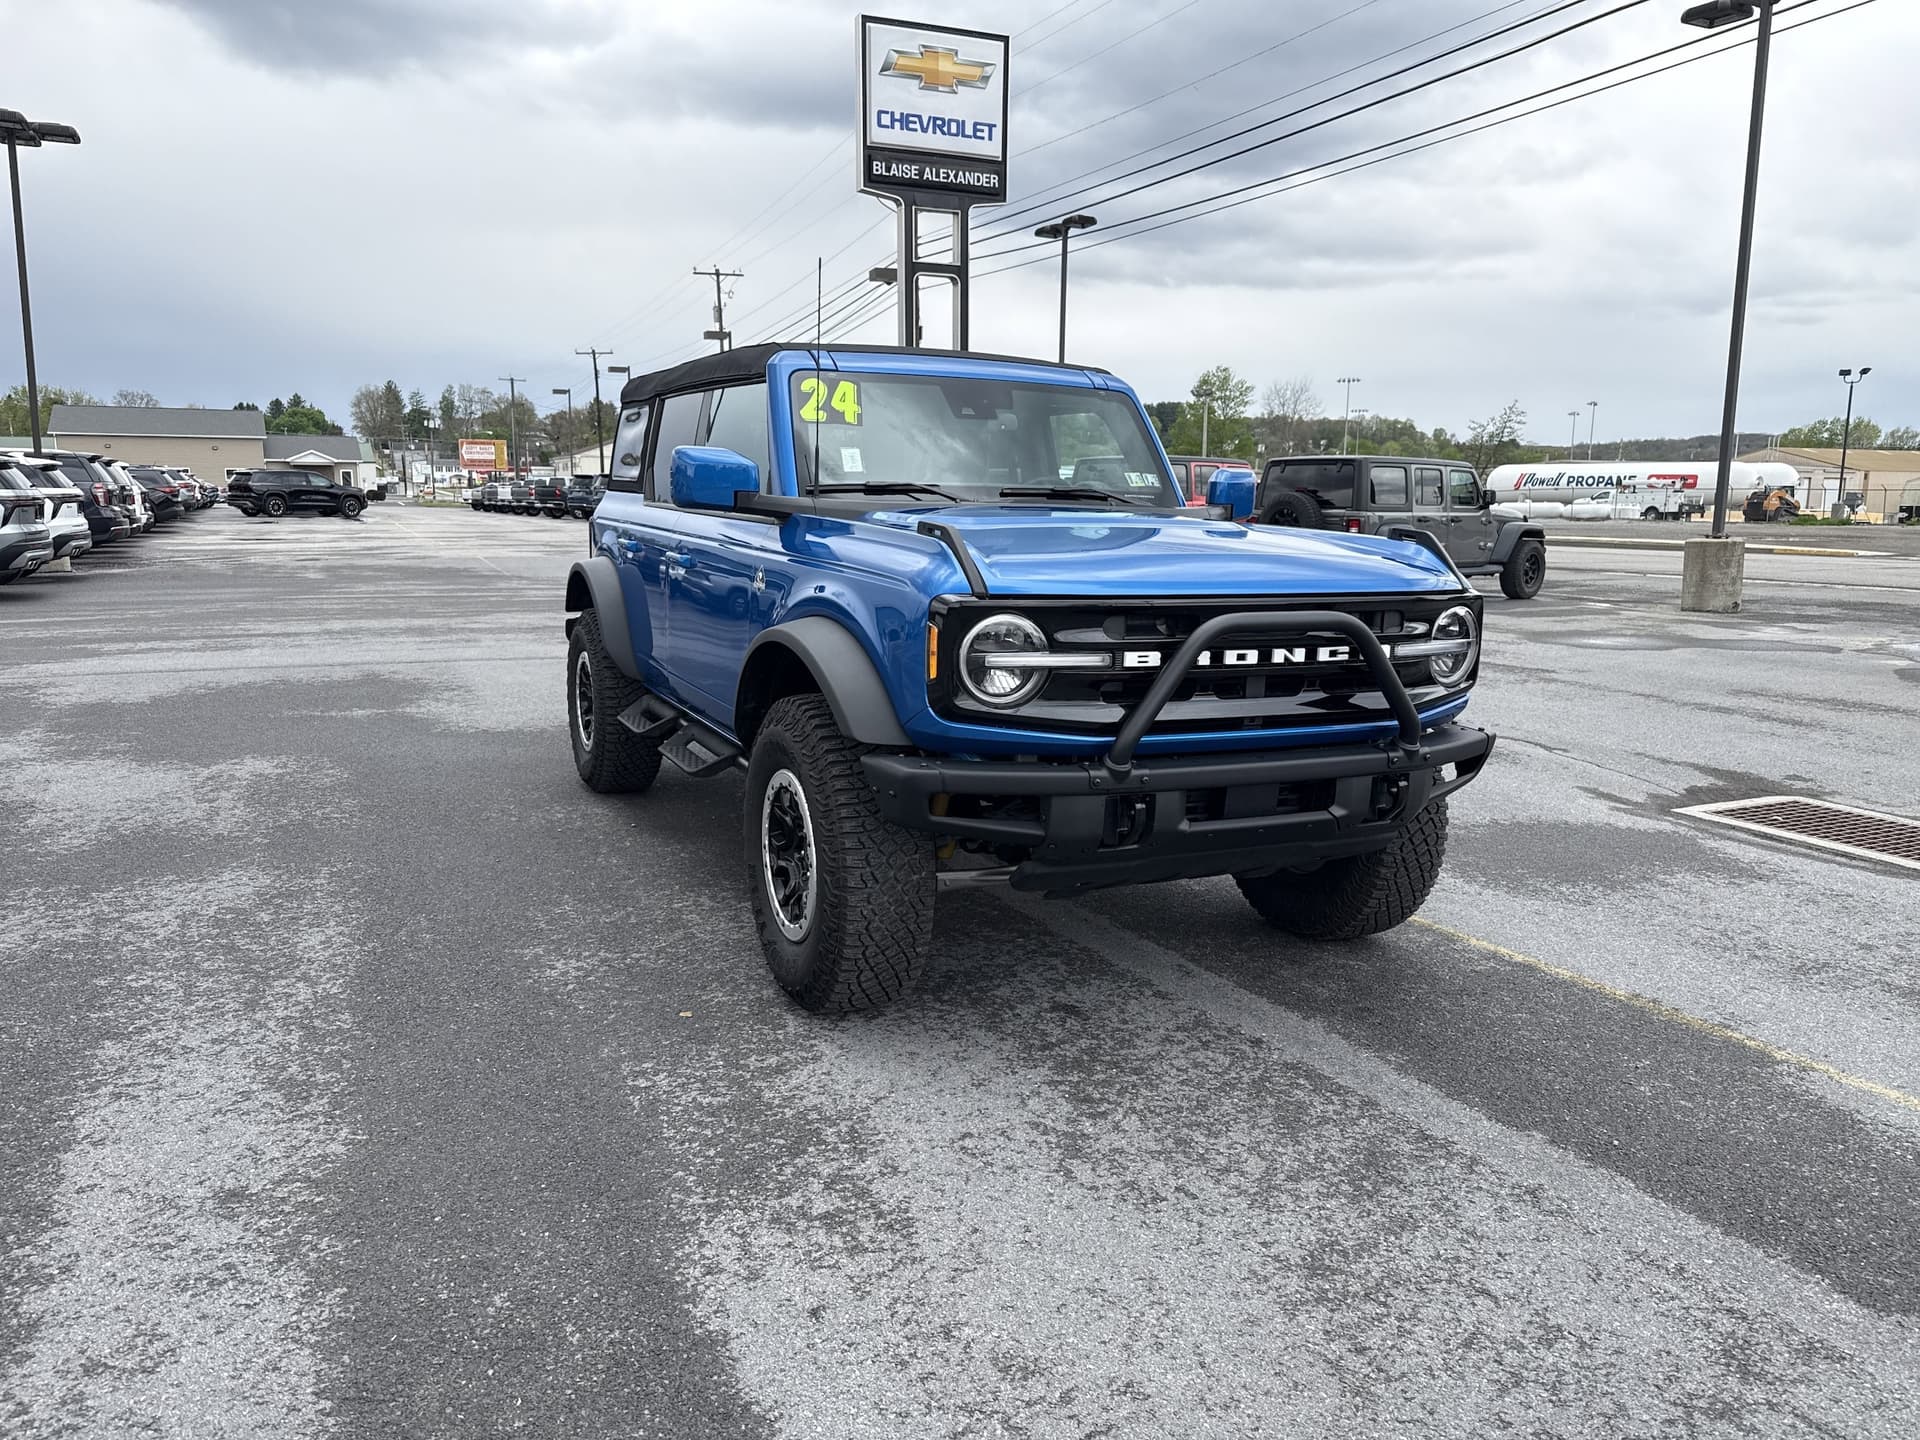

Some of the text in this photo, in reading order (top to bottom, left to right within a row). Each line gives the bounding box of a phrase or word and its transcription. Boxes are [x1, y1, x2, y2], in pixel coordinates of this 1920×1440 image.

[876, 109, 997, 141] CHEVROLET
[872, 161, 999, 188] BLAISE ALEXANDER
[800, 377, 861, 425] 24
[1522, 472, 1566, 488] Powell
